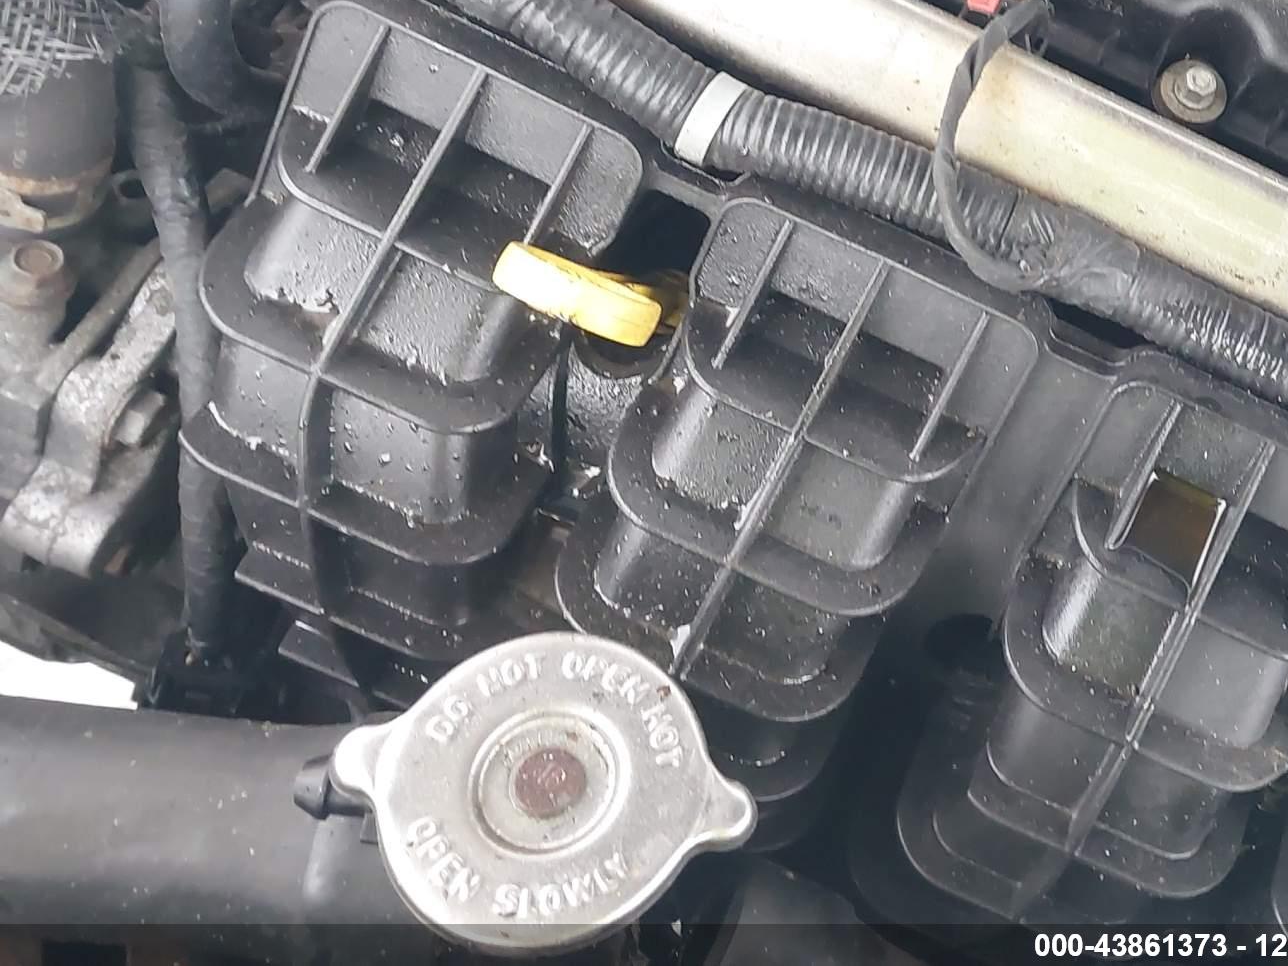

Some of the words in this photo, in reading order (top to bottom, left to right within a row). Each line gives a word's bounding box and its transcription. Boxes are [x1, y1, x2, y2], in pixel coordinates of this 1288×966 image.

[425, 696, 471, 743] DO
[477, 653, 546, 696] NOT
[561, 651, 649, 705] OPEN
[641, 700, 681, 768] HOT
[407, 817, 481, 902] OPEN
[492, 850, 628, 919] SLOWLY
